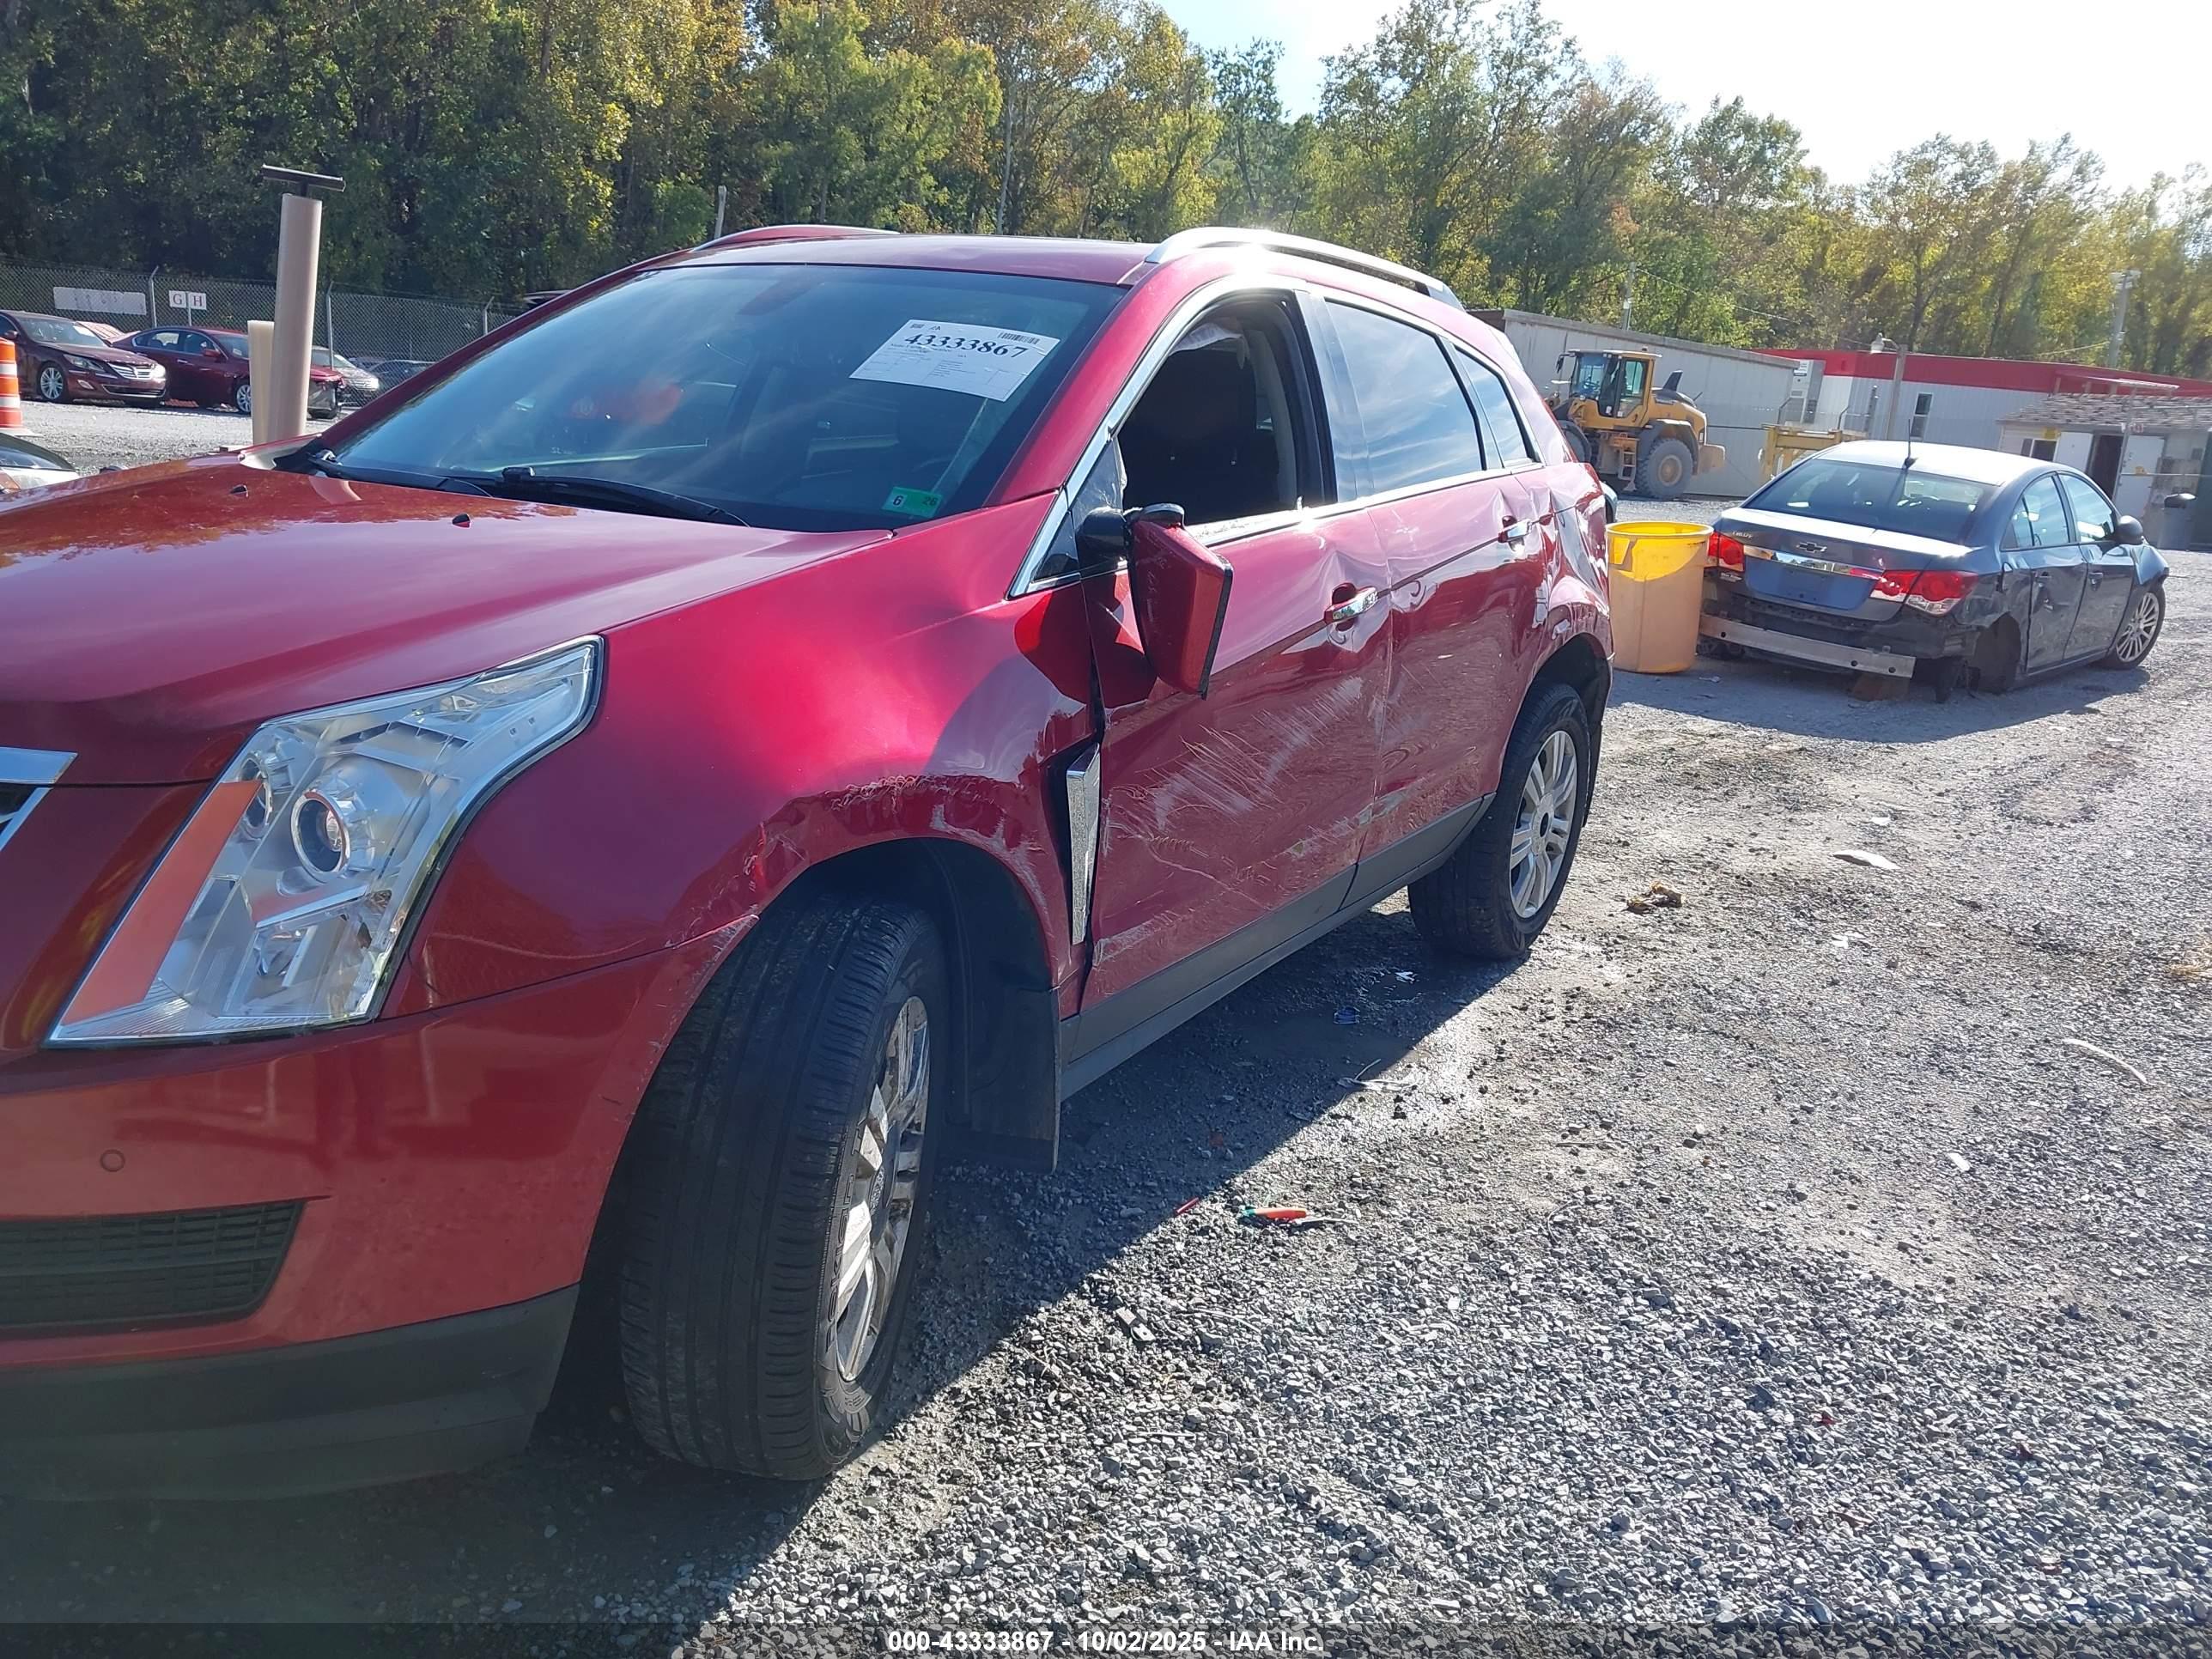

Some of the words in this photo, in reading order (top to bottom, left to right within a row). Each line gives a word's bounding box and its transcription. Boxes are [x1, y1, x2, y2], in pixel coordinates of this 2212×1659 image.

[173, 293, 183, 305] G
[193, 295, 203, 307] H
[904, 332, 1028, 358] 43333867
[892, 495, 904, 506] 6
